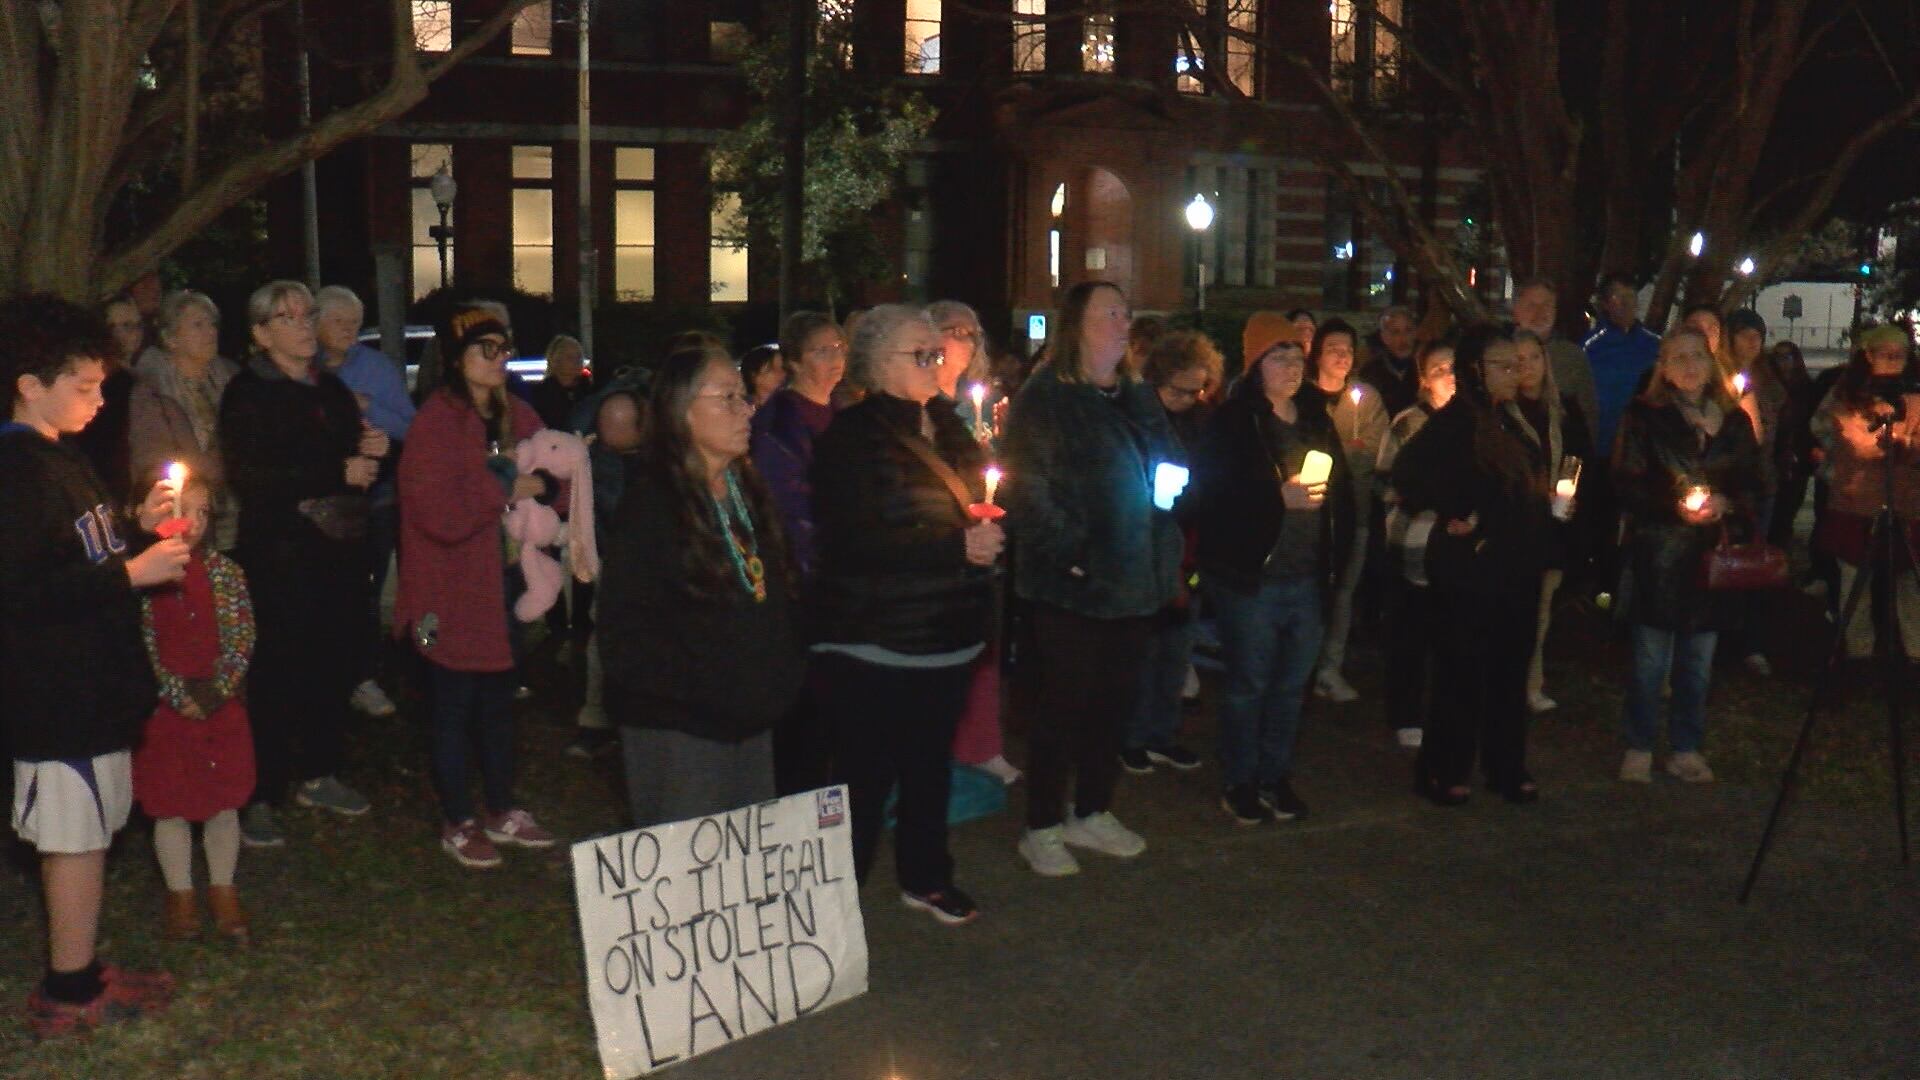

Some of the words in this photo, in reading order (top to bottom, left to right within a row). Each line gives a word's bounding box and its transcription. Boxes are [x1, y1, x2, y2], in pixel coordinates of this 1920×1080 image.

[595, 831, 661, 894] NO
[690, 800, 782, 865] ONE
[612, 876, 671, 942] IS
[687, 837, 843, 922] ILLEGAL
[605, 934, 656, 995] ON
[663, 889, 817, 981] STOLEN
[635, 941, 835, 1068] LAND
